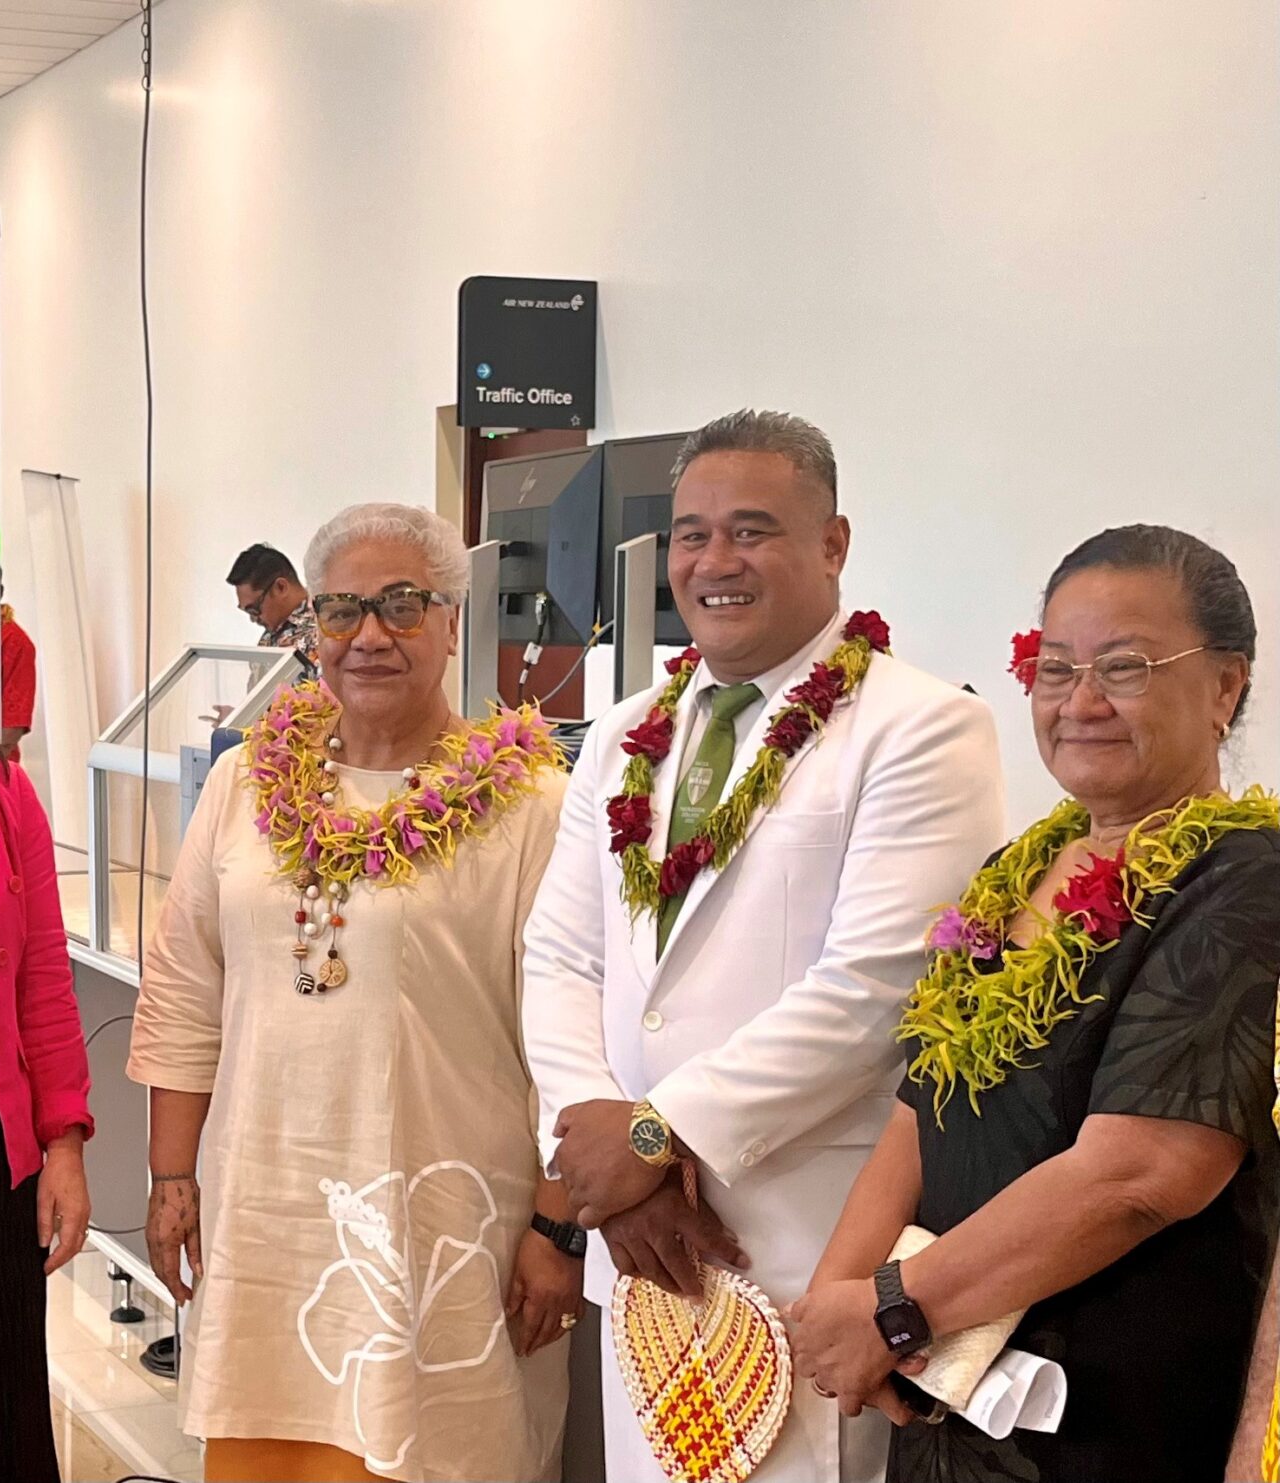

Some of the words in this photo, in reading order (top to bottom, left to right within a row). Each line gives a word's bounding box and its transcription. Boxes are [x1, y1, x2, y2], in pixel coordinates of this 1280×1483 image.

[518, 299, 535, 308] NEW
[535, 300, 570, 309] ZEALAND
[476, 386, 524, 404] Traffic
[527, 387, 573, 405] Office
